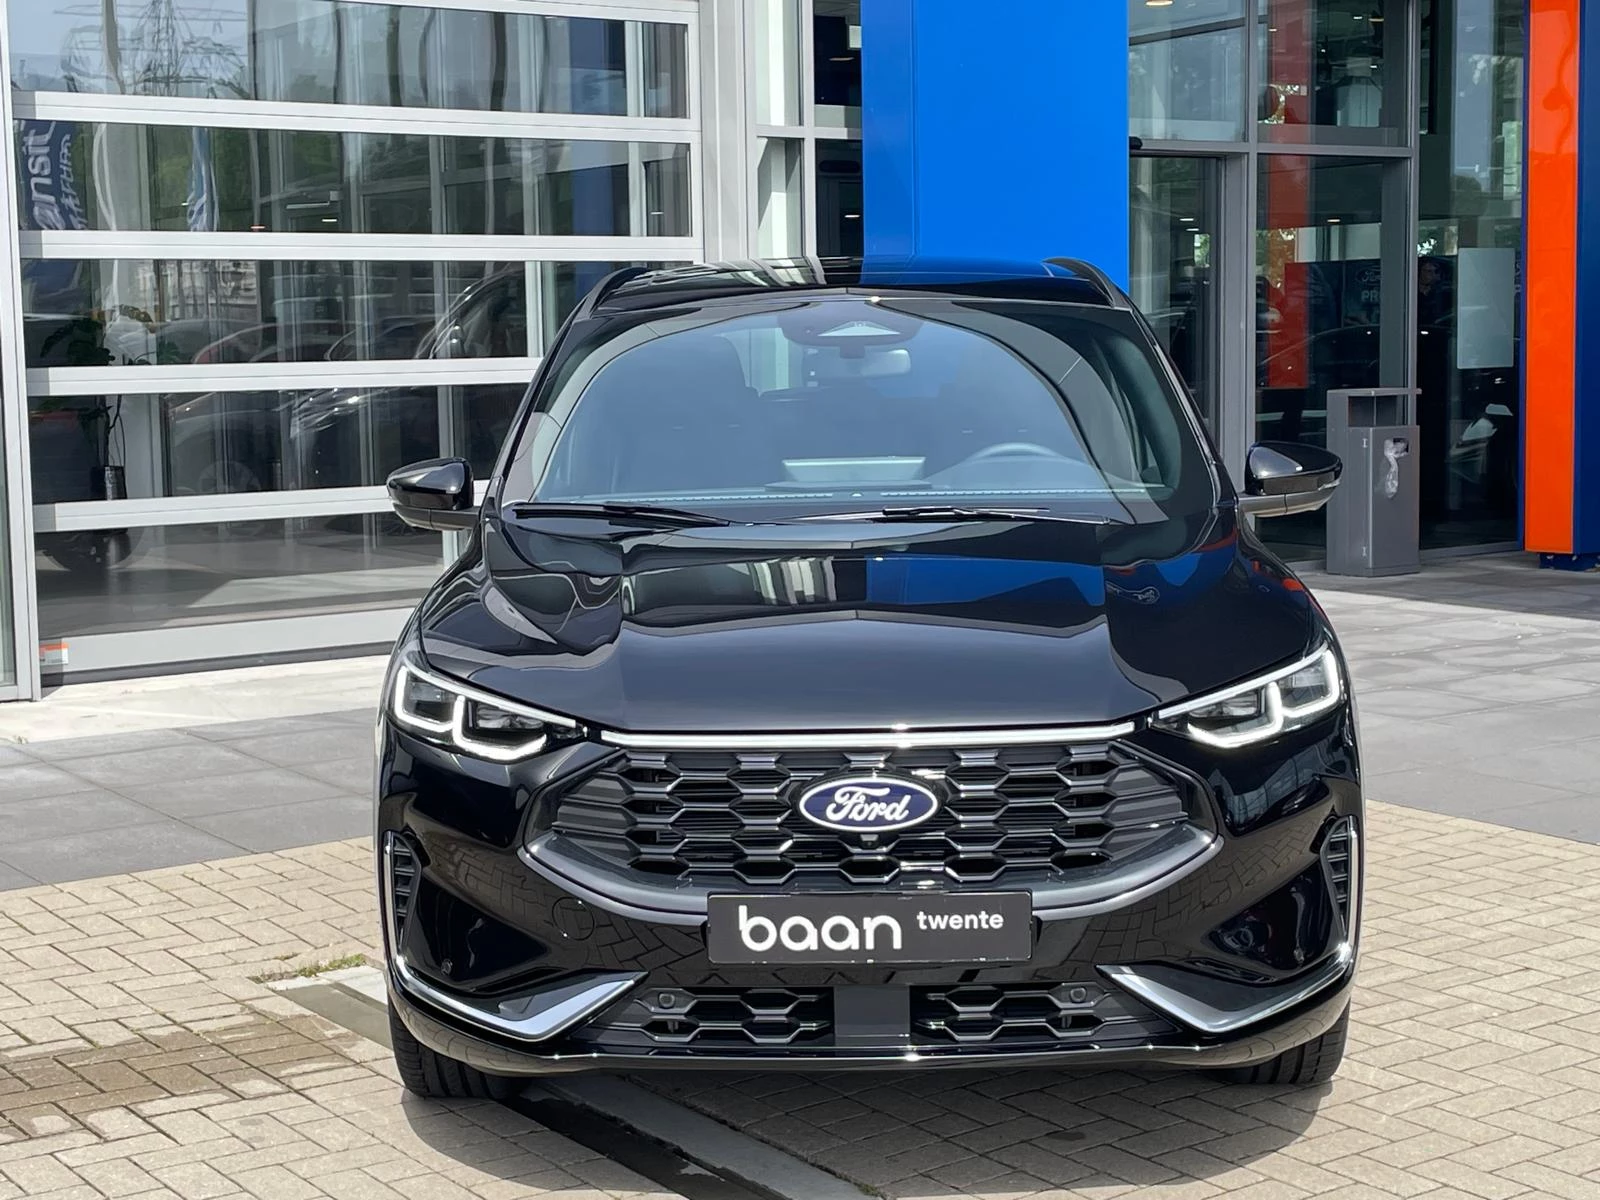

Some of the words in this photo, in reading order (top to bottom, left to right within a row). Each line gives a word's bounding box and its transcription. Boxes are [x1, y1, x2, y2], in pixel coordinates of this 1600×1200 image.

[826, 786, 911, 821] Ford
[738, 905, 902, 952] baan
[916, 910, 1004, 930] twente
